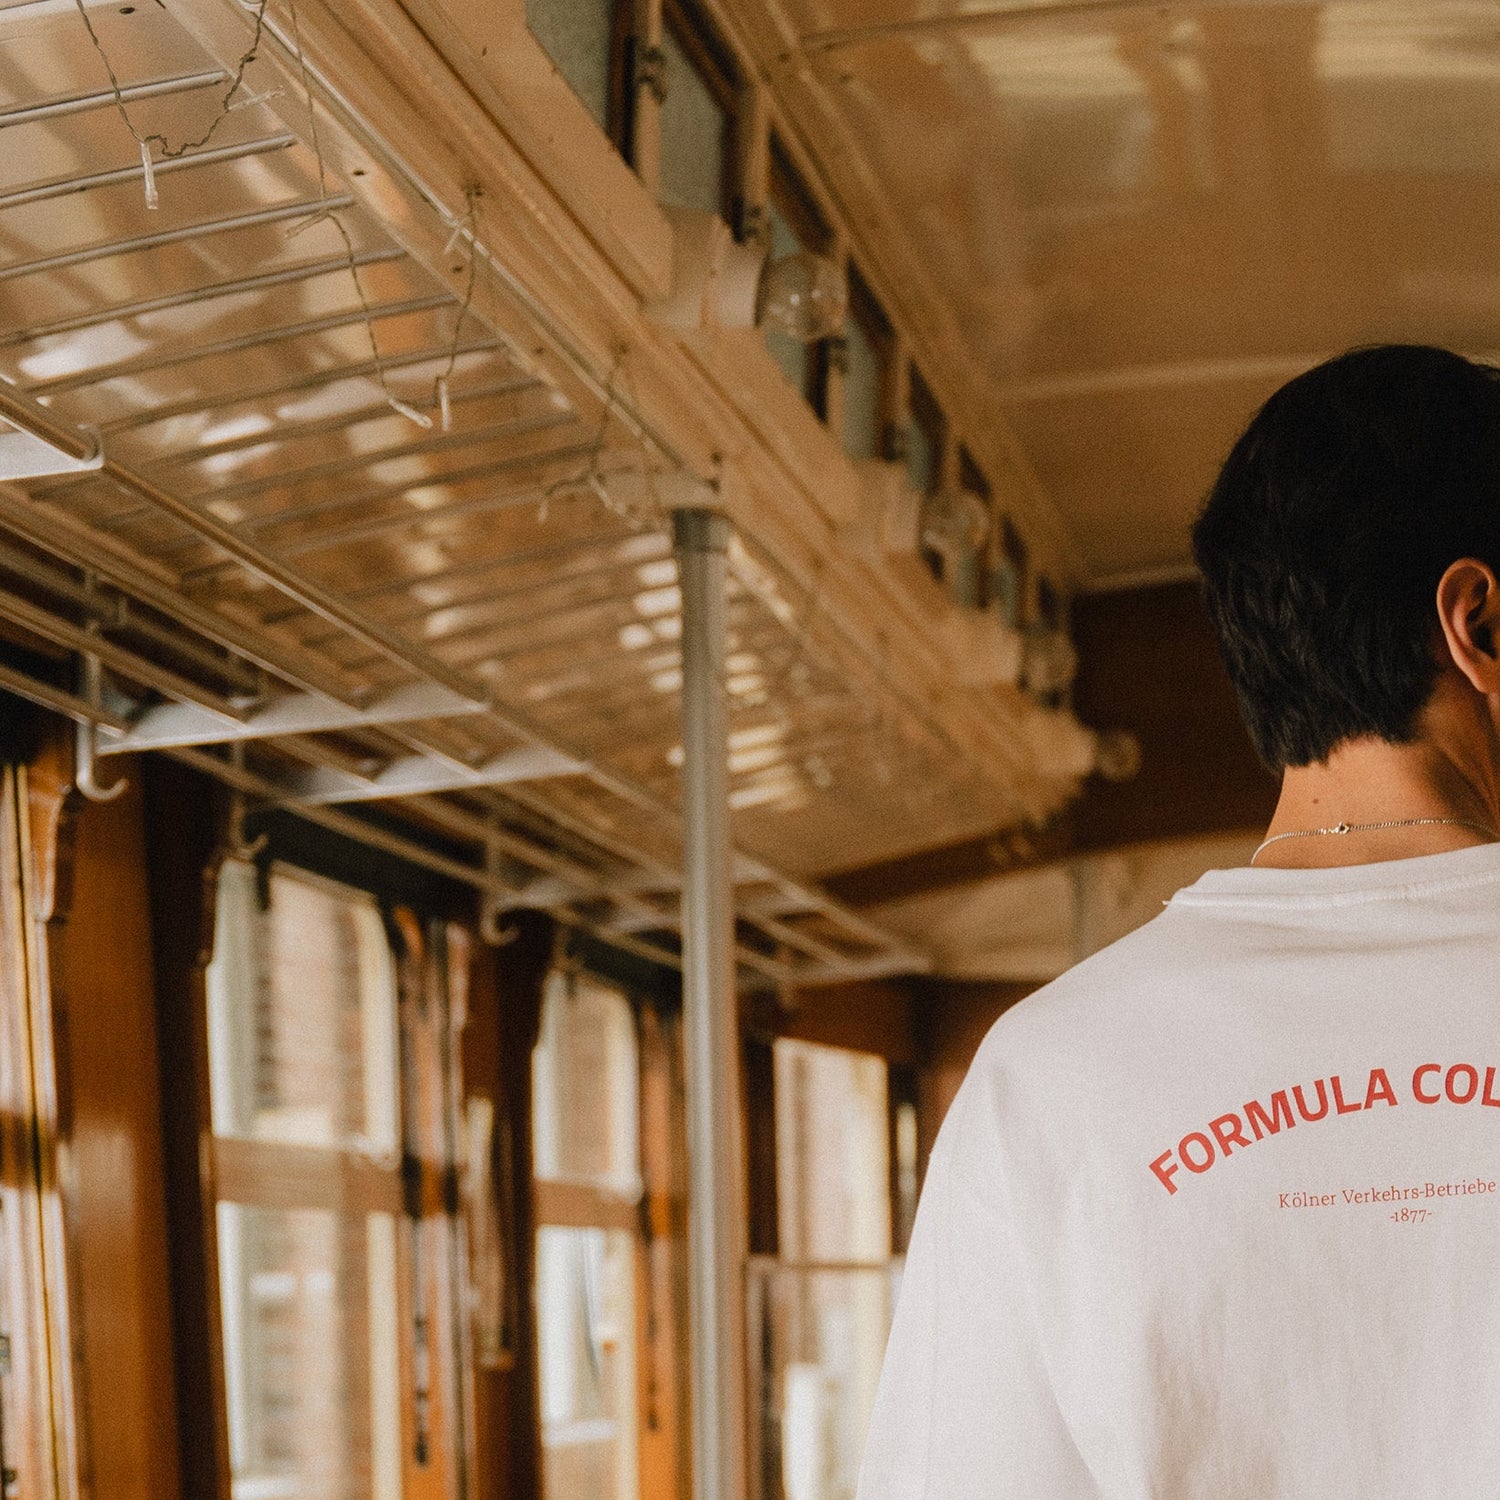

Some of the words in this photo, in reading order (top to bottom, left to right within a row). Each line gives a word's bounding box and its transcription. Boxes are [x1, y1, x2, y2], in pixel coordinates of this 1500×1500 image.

[1149, 1068, 1398, 1196] FORMULA
[1279, 1192, 1337, 1208] Kölner
[1342, 1178, 1496, 1204] Verkehrs-Betriebe
